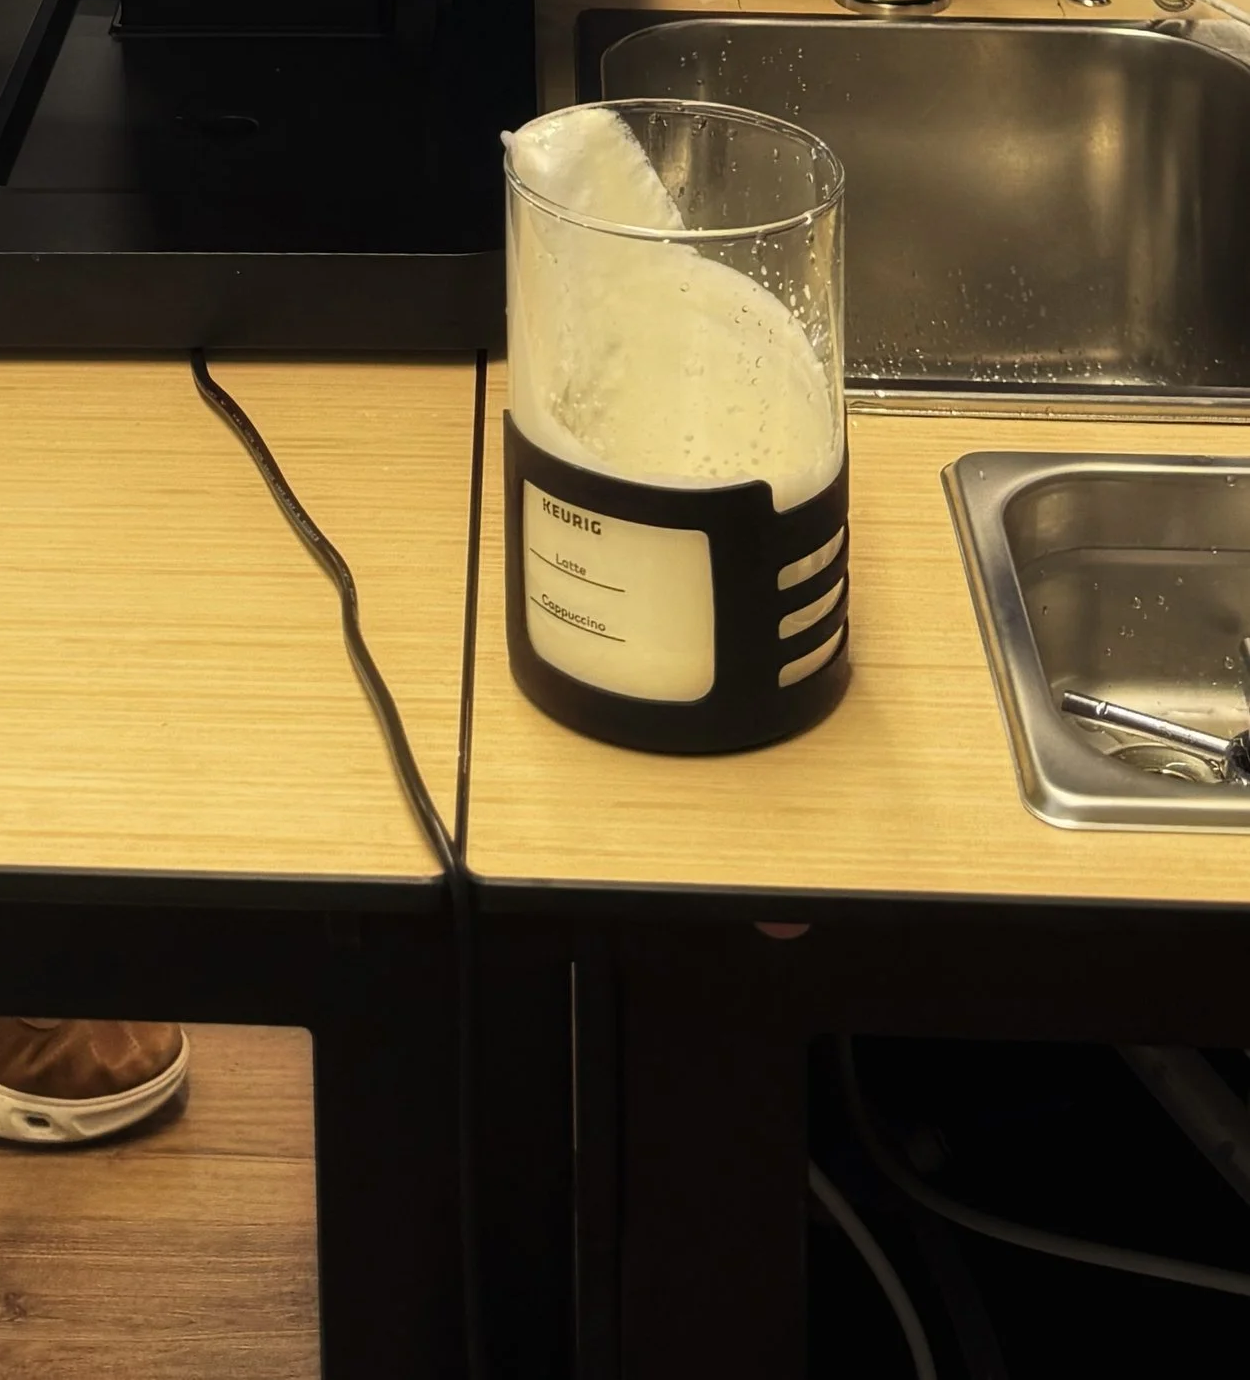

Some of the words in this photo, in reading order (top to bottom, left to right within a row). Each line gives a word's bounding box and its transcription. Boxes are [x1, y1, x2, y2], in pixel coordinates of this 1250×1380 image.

[542, 497, 602, 536] KEURIG
[556, 553, 587, 577] Latte
[541, 593, 607, 632] Cappuccino
